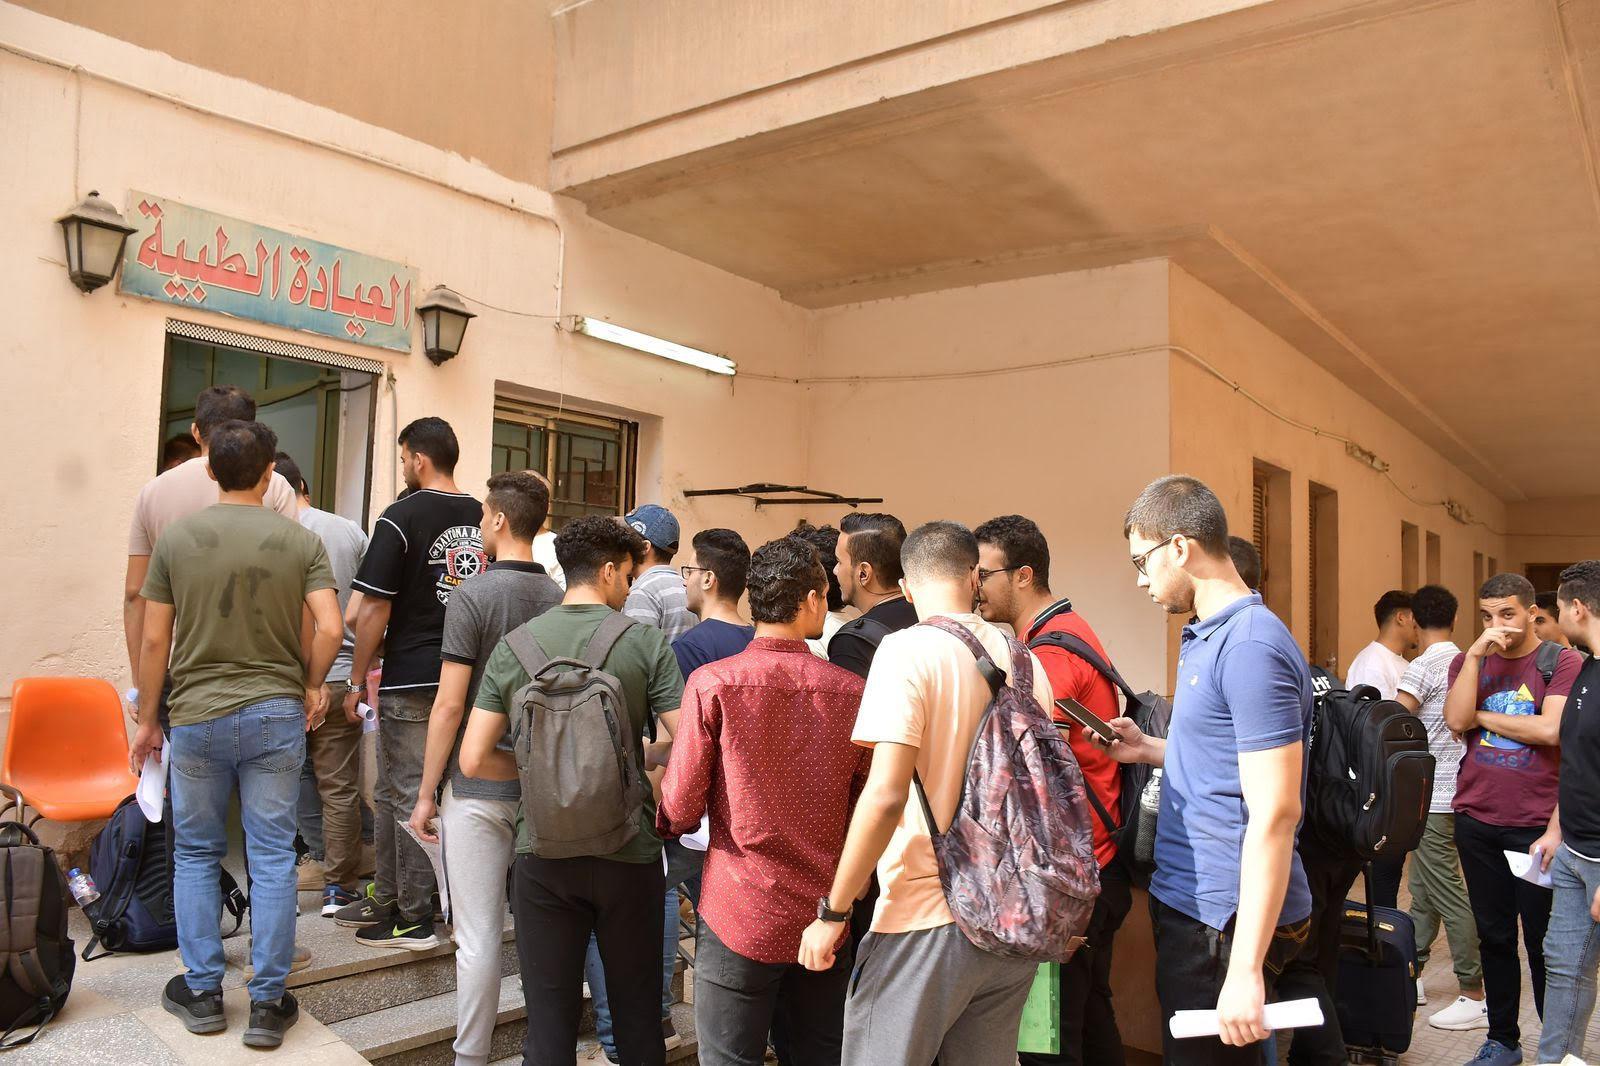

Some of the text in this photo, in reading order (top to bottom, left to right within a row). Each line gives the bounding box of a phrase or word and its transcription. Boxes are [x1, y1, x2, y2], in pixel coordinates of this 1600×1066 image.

[137, 199, 411, 337] العيادة الطبية
[435, 527, 468, 551] DAYTONA
